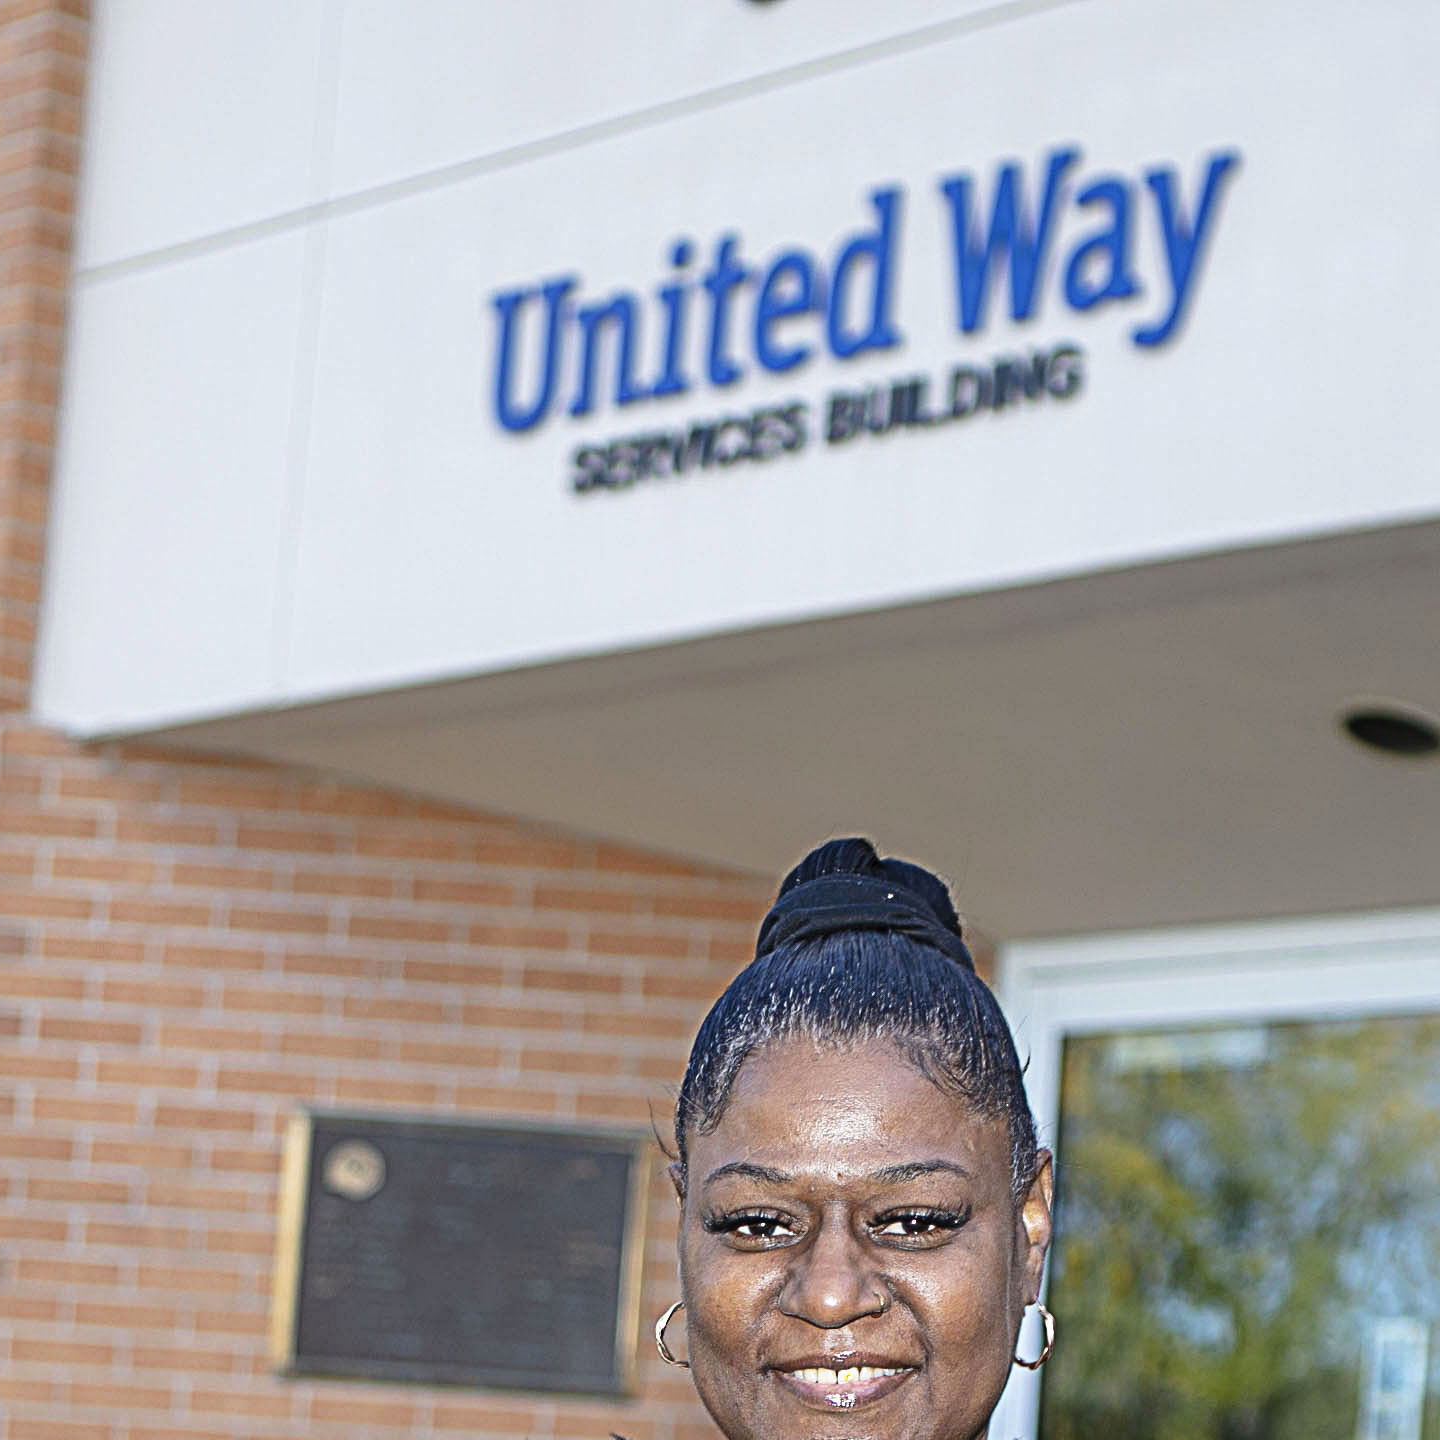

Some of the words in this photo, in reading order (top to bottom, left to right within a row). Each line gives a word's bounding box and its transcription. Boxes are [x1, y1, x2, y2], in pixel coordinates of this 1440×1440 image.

[489, 183, 904, 433] United
[938, 146, 1241, 348] Way
[568, 403, 807, 496] SERVICES
[824, 347, 1084, 446] BUILDING
